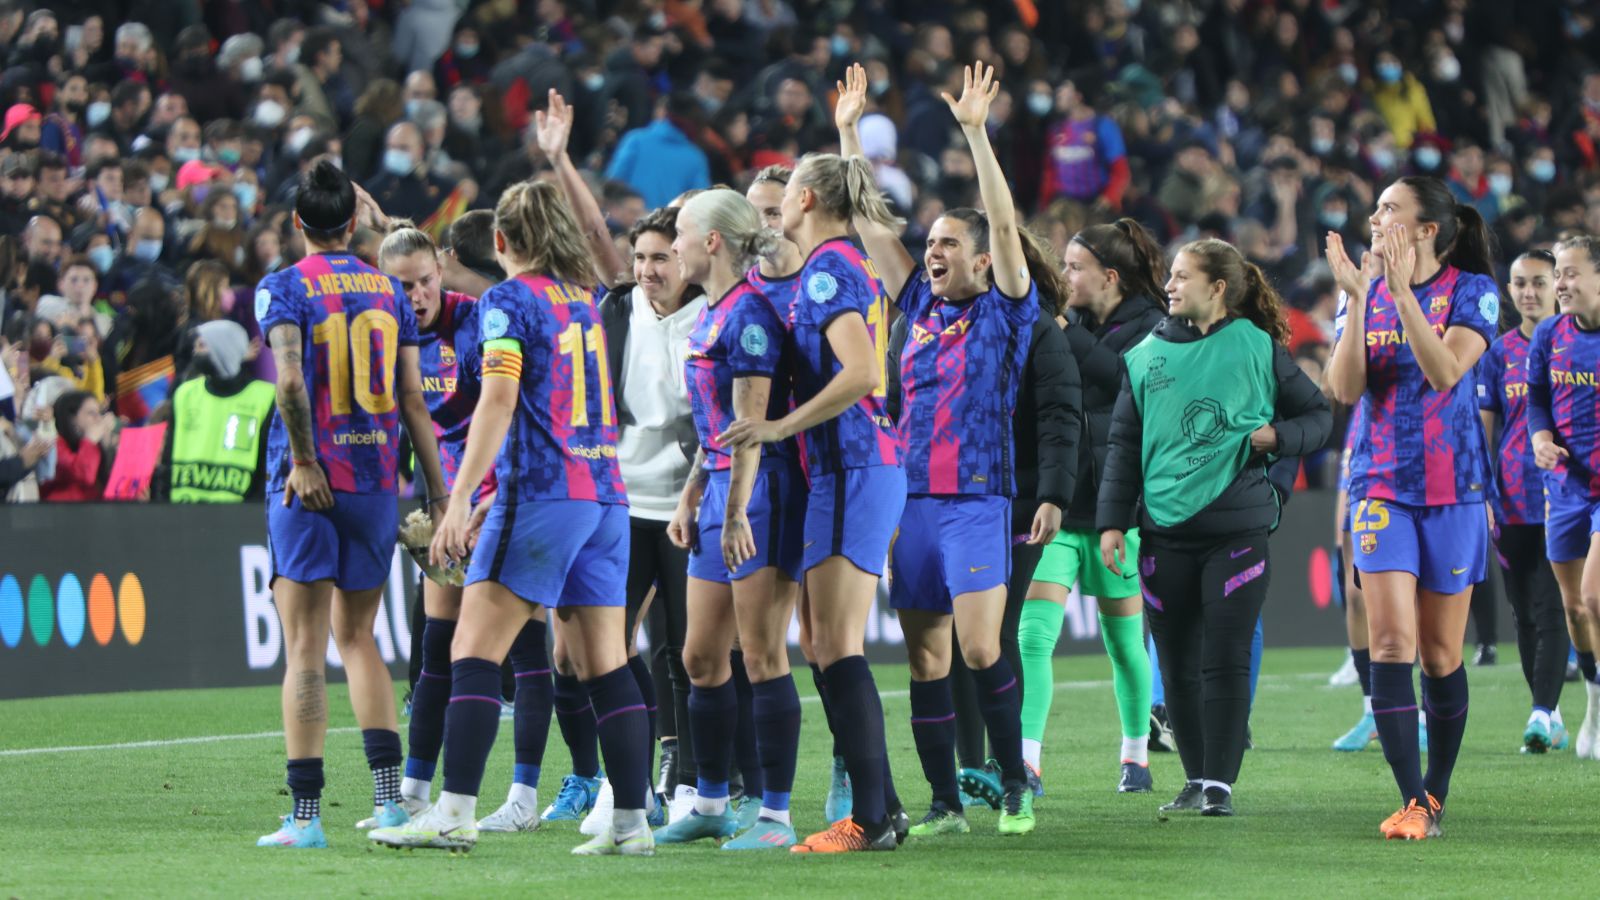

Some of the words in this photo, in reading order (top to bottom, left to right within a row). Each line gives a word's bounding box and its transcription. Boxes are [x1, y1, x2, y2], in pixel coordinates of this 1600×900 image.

[313, 308, 399, 416] 10
[558, 322, 611, 427] 11
[333, 429, 377, 445] unicef
